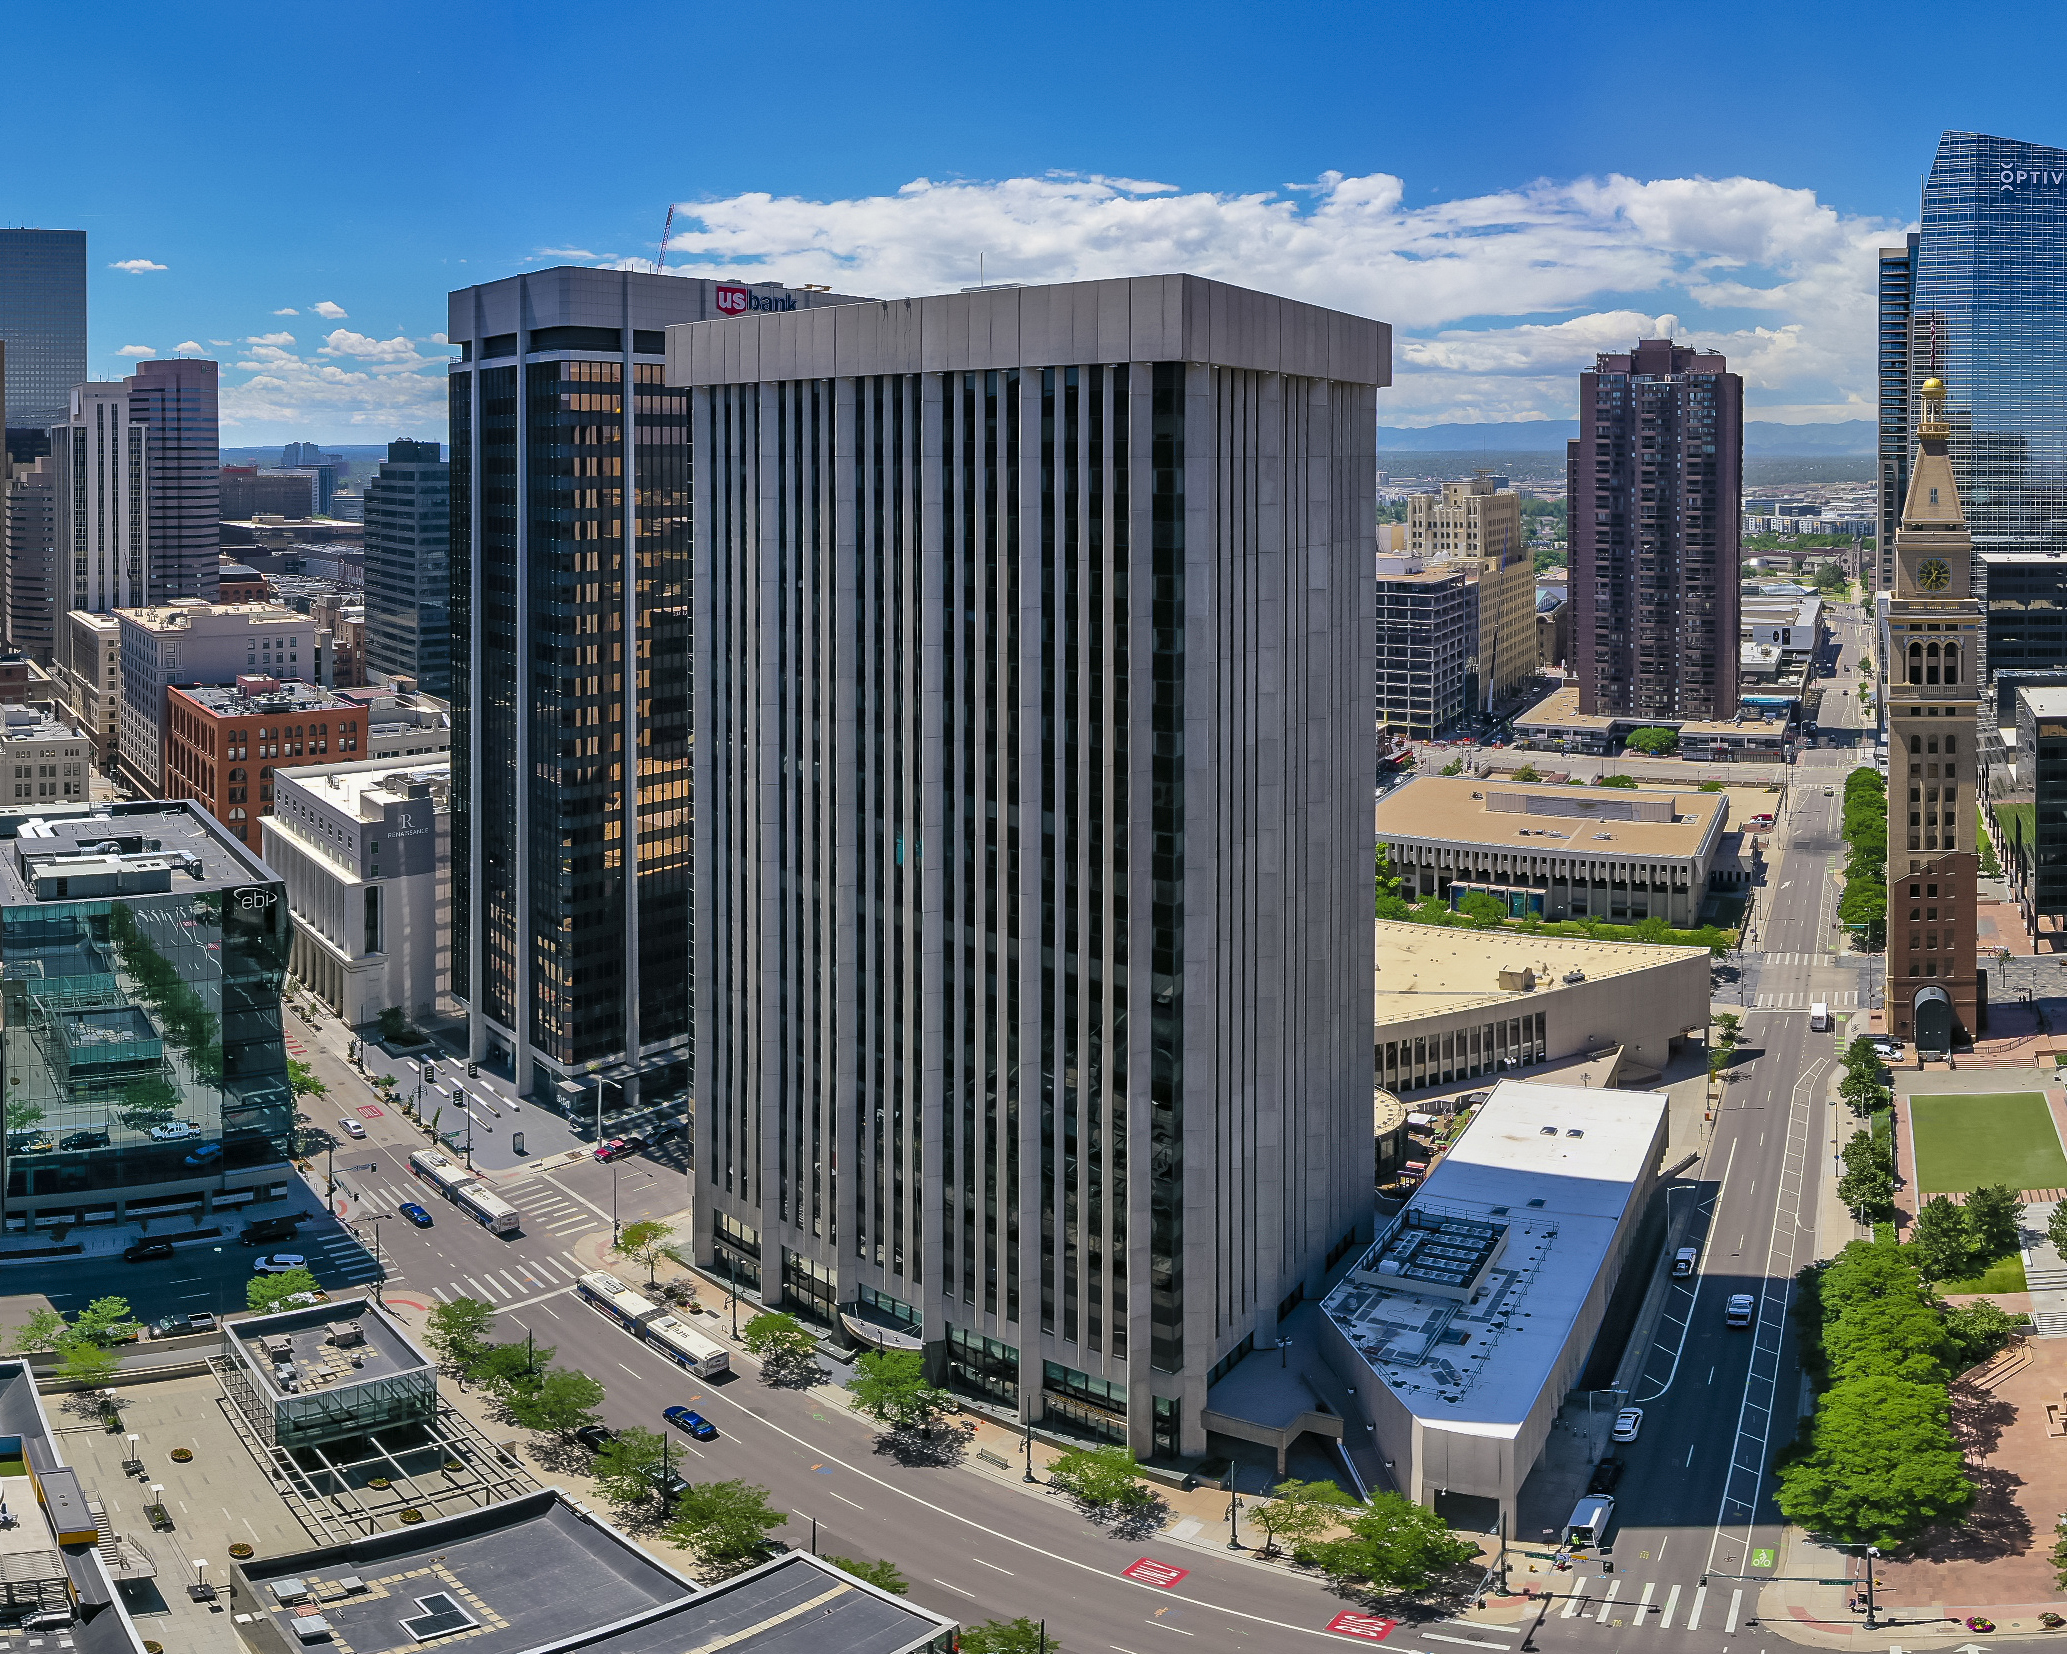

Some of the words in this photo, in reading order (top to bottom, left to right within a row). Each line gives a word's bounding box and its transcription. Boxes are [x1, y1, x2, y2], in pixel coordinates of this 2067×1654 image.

[2001, 170, 2063, 185] OPTIV
[401, 814, 415, 829] R
[241, 890, 269, 910] ebi
[1130, 1559, 1180, 1585] ONLY
[1334, 1615, 1387, 1637] BUS
